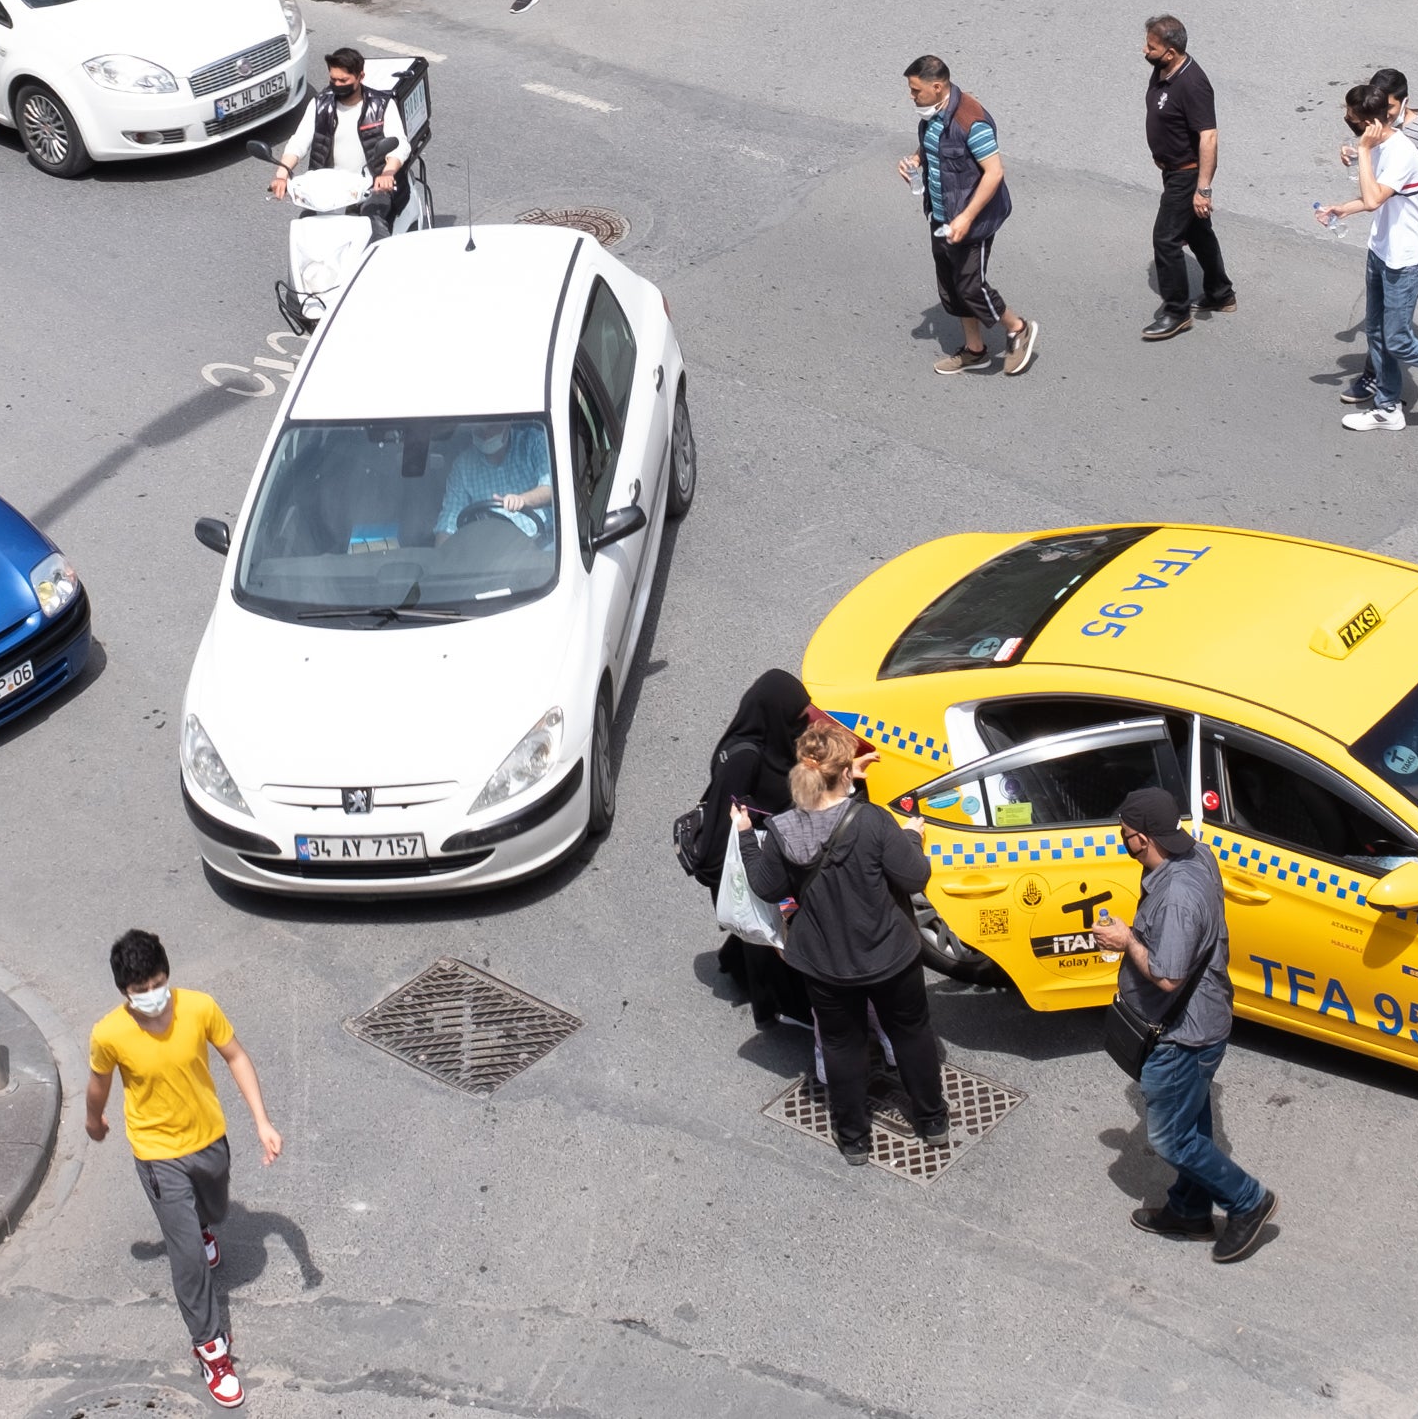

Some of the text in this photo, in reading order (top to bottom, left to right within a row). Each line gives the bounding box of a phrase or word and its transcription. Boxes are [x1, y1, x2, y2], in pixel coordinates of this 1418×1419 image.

[222, 76, 285, 113] 34 HL 0052
[1080, 545, 1212, 639] TFA 95
[13, 664, 33, 687] 06
[308, 837, 419, 858] 34 AY 7157
[1331, 920, 1364, 936] ATAKENT
[1059, 955, 1090, 970] Kolay
[1249, 954, 1359, 1025] TFA
